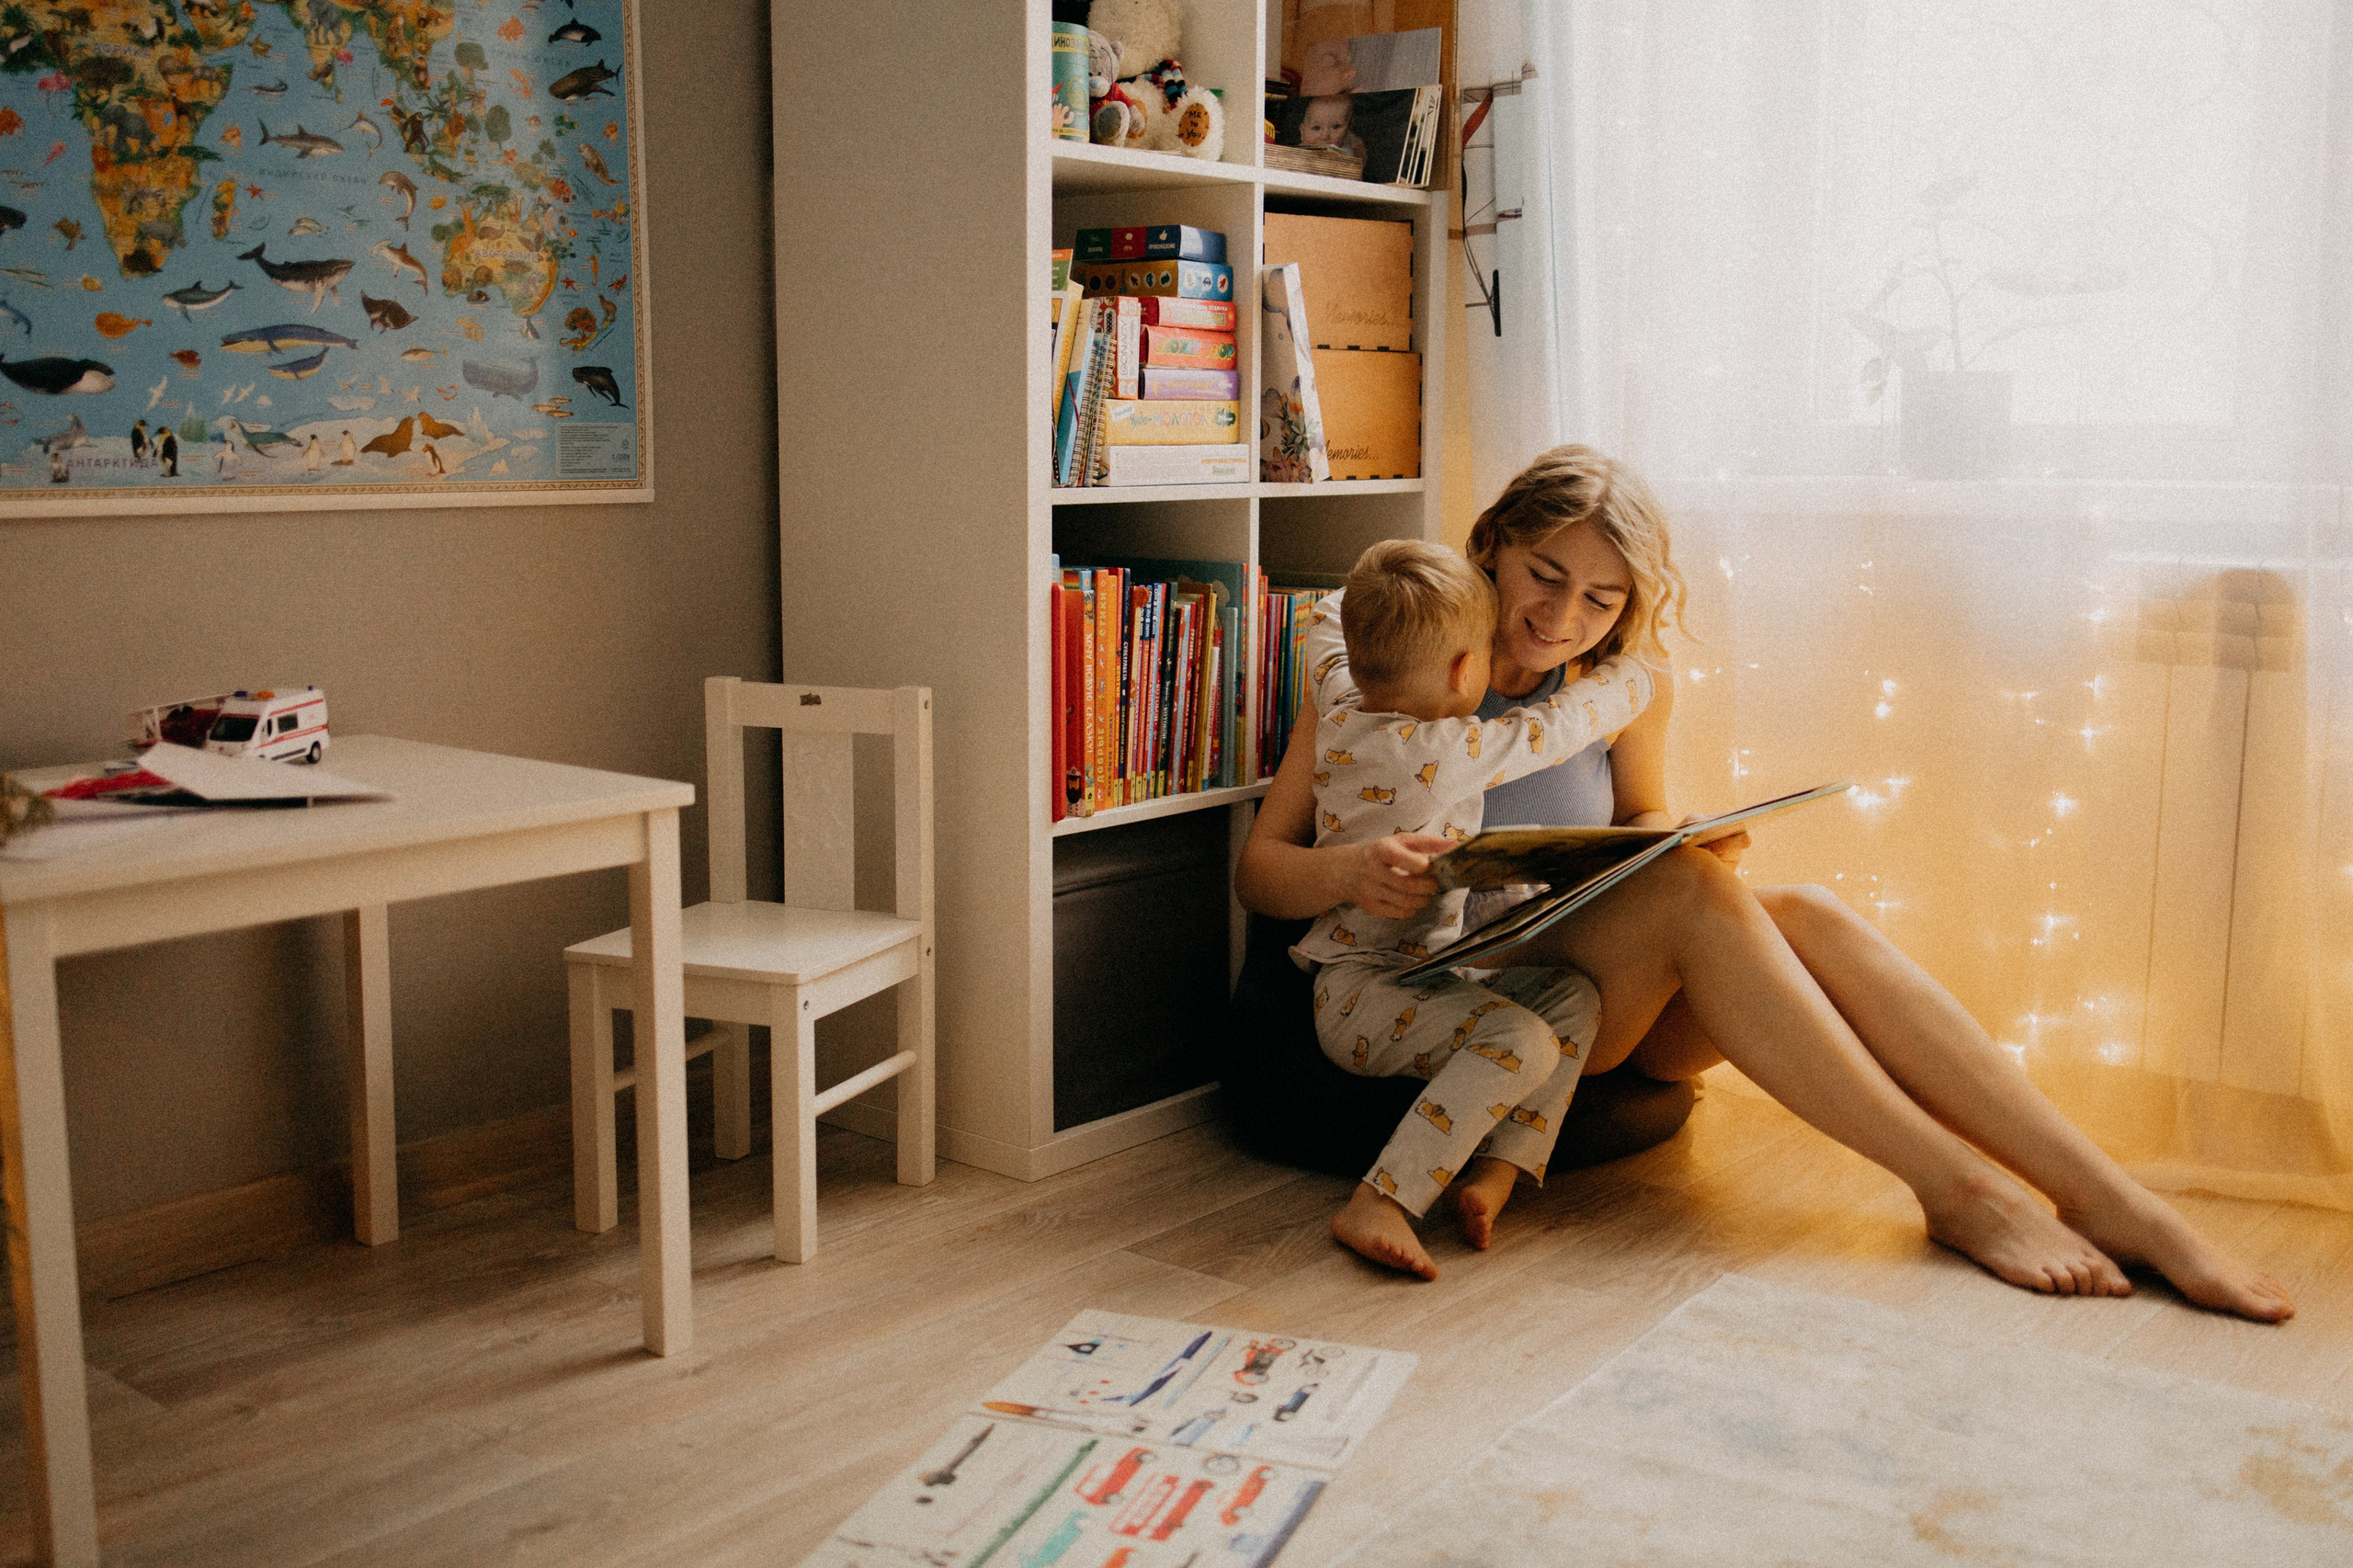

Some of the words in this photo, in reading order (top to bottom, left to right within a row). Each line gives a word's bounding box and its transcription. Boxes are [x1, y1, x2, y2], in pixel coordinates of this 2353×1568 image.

[93, 42, 151, 58] АФРИКА
[474, 248, 540, 263] АВСТРАЛИЯ
[1325, 439, 1379, 460] emories...
[66, 458, 159, 470] АНТАРКТИДА
[1085, 632, 1093, 659] ХОЧУ
[1085, 665, 1093, 701] НОВУЮ
[1085, 707, 1093, 754] СКАЗКУ!
[1097, 728, 1105, 783] ДОБРЫЕ
